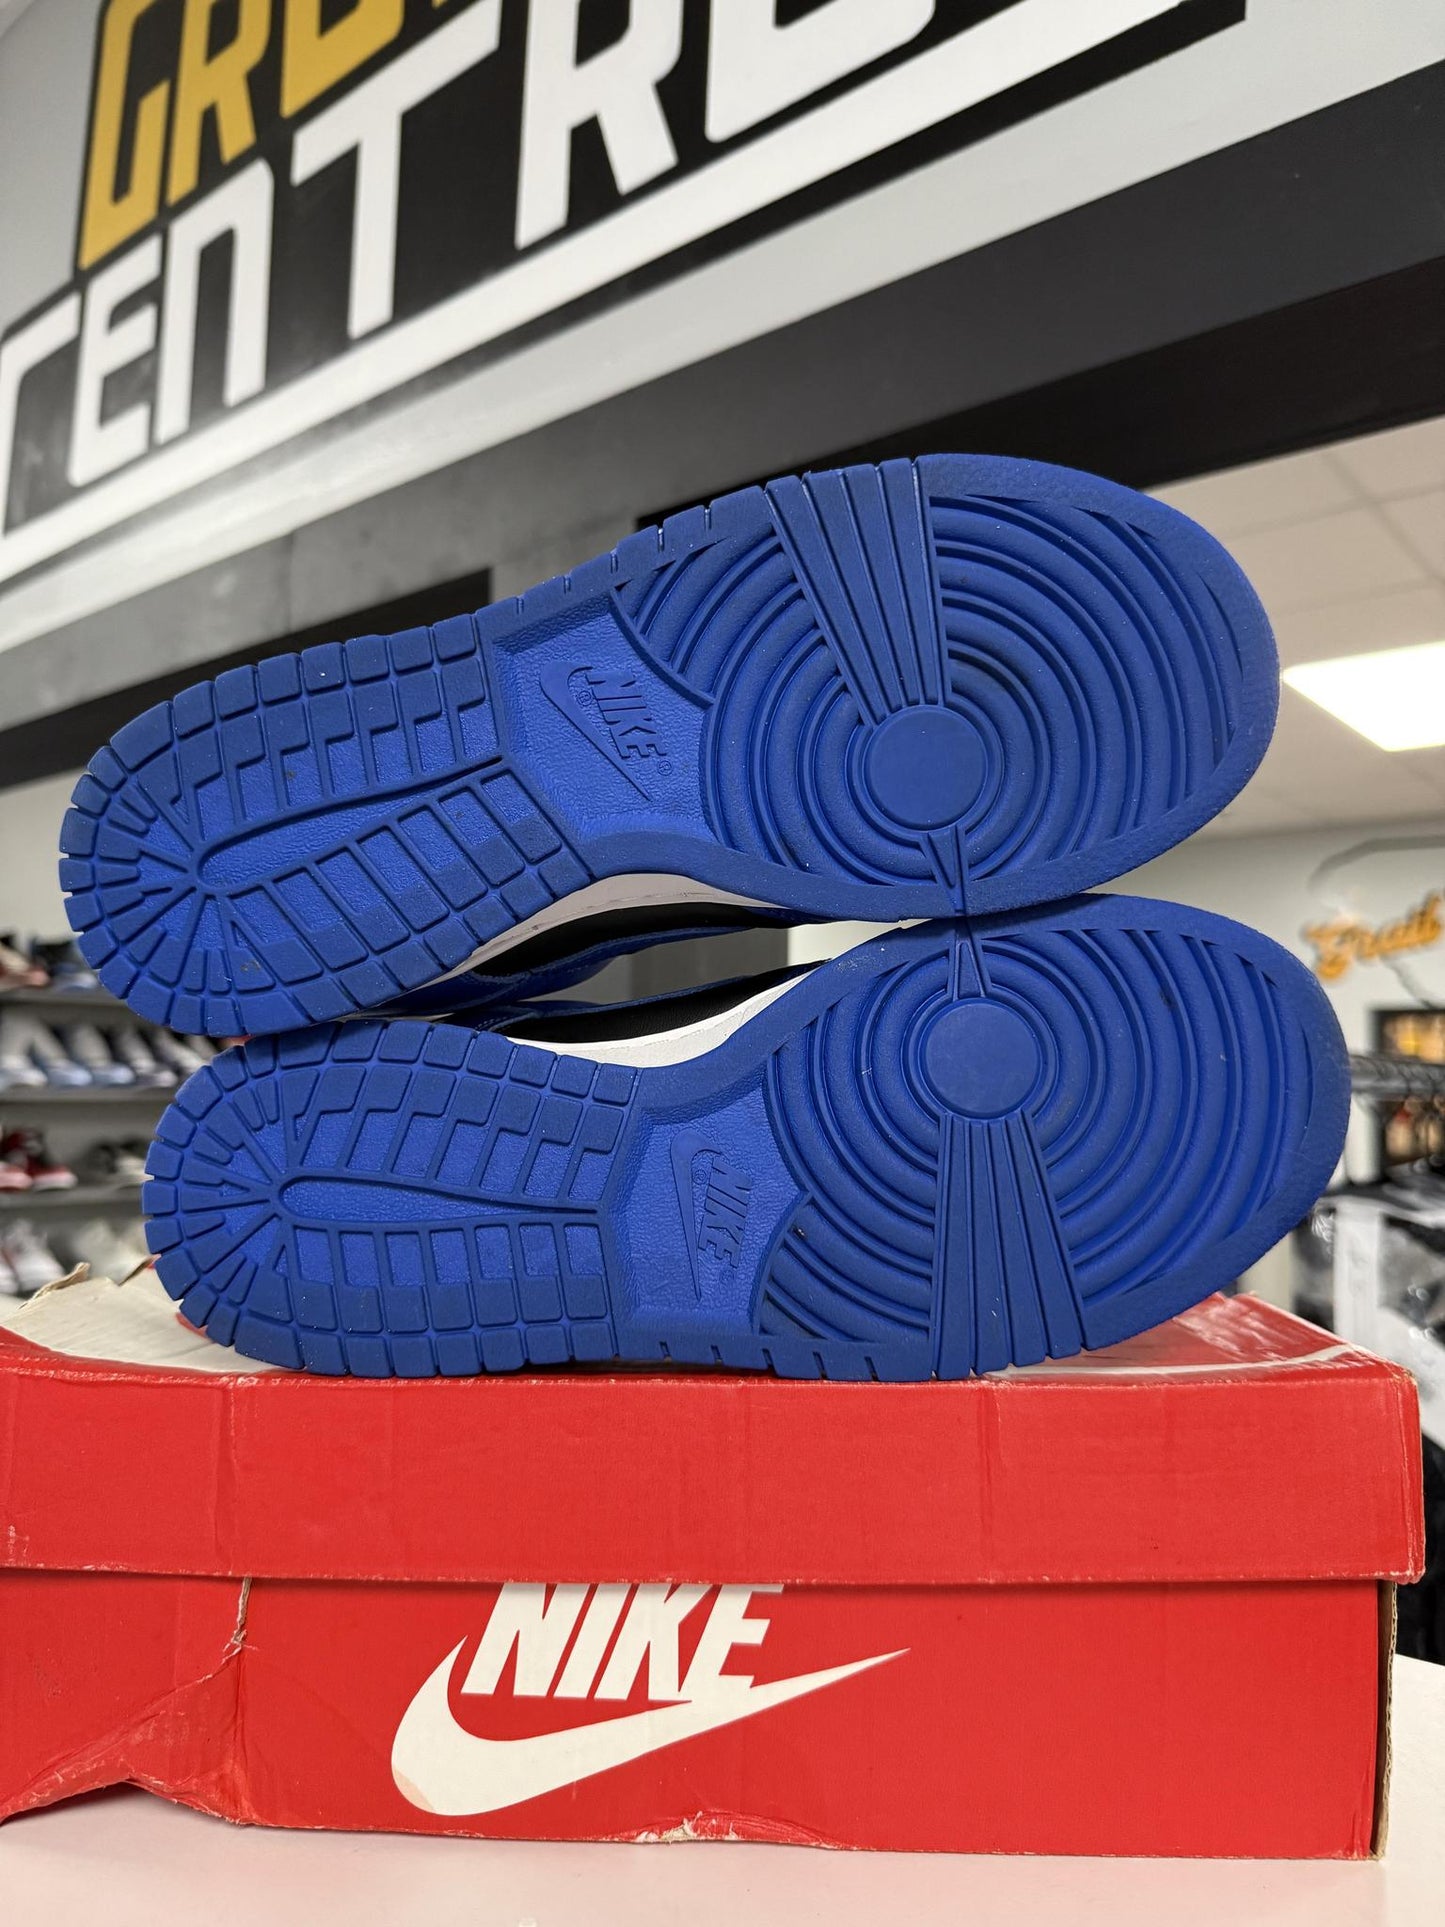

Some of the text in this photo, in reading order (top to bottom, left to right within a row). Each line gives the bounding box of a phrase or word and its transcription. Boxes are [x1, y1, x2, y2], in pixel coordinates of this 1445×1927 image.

[584, 668, 668, 760] NIKE
[697, 1156, 752, 1268] NIKE
[460, 1582, 785, 1702] NIKE
